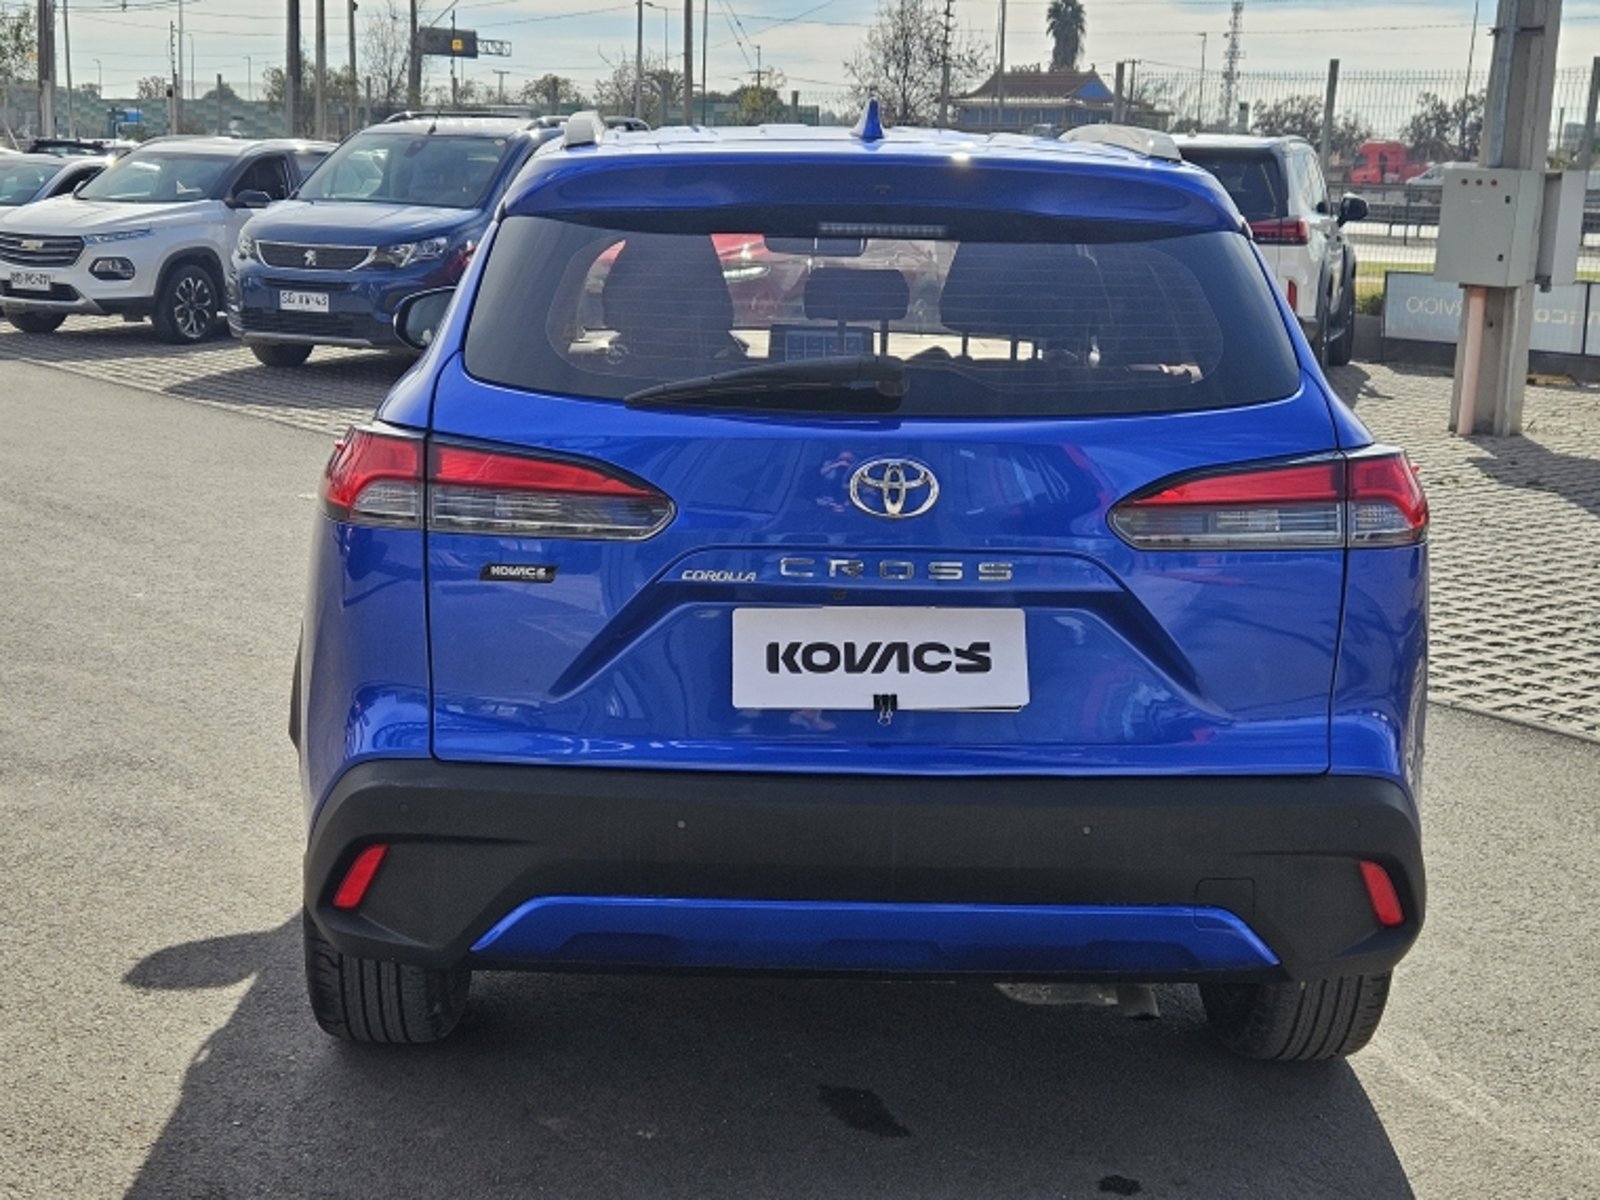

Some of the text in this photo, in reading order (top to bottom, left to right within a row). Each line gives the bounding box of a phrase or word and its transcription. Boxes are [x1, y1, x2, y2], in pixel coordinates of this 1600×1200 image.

[490, 565, 547, 579] KOVACS
[681, 557, 1013, 582] COROLLA CROSS
[766, 641, 992, 674] KOVACS
